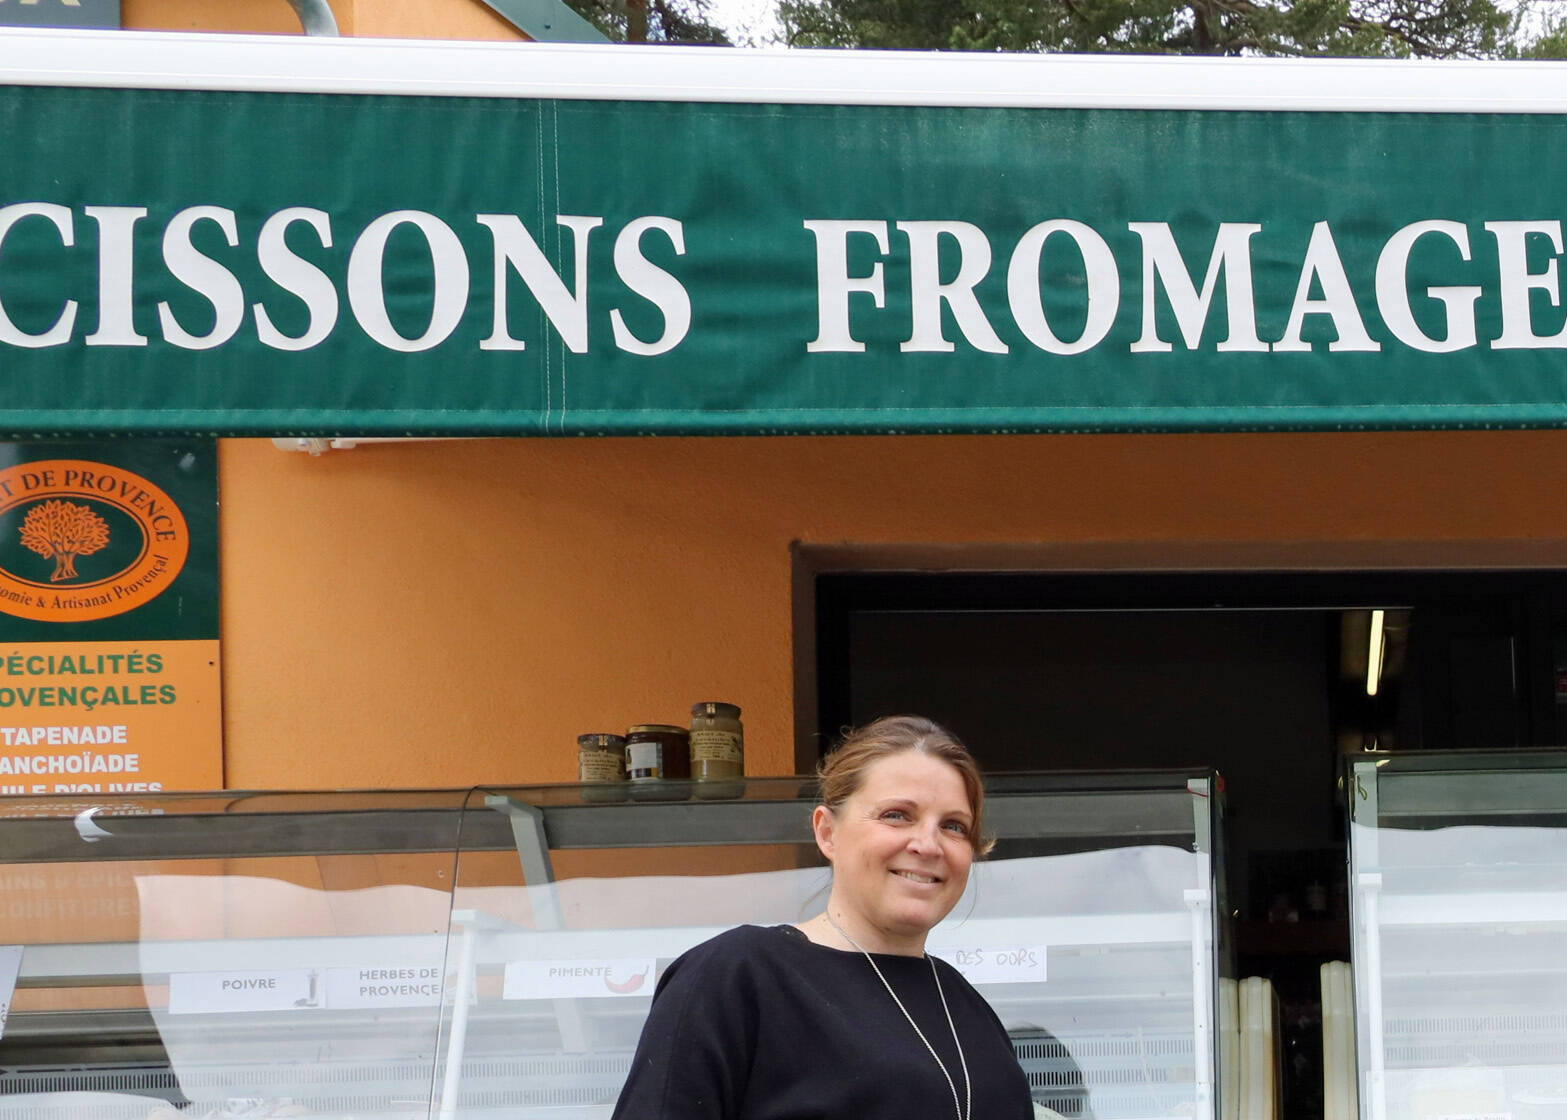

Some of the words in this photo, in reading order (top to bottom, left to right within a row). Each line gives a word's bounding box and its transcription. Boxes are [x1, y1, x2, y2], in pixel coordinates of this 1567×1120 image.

[0, 202, 692, 357] CISSONS
[21, 470, 56, 491] DE
[64, 470, 176, 542] PROVENCE
[36, 597, 45, 607] &
[51, 593, 113, 610] Artisanat
[112, 554, 169, 599] Provençal
[2, 726, 128, 746] TAPENADE
[0, 752, 139, 775] ANCHOÏADE
[222, 977, 276, 991] POIVRE
[359, 969, 416, 980] HERBES
[419, 968, 439, 979] DE
